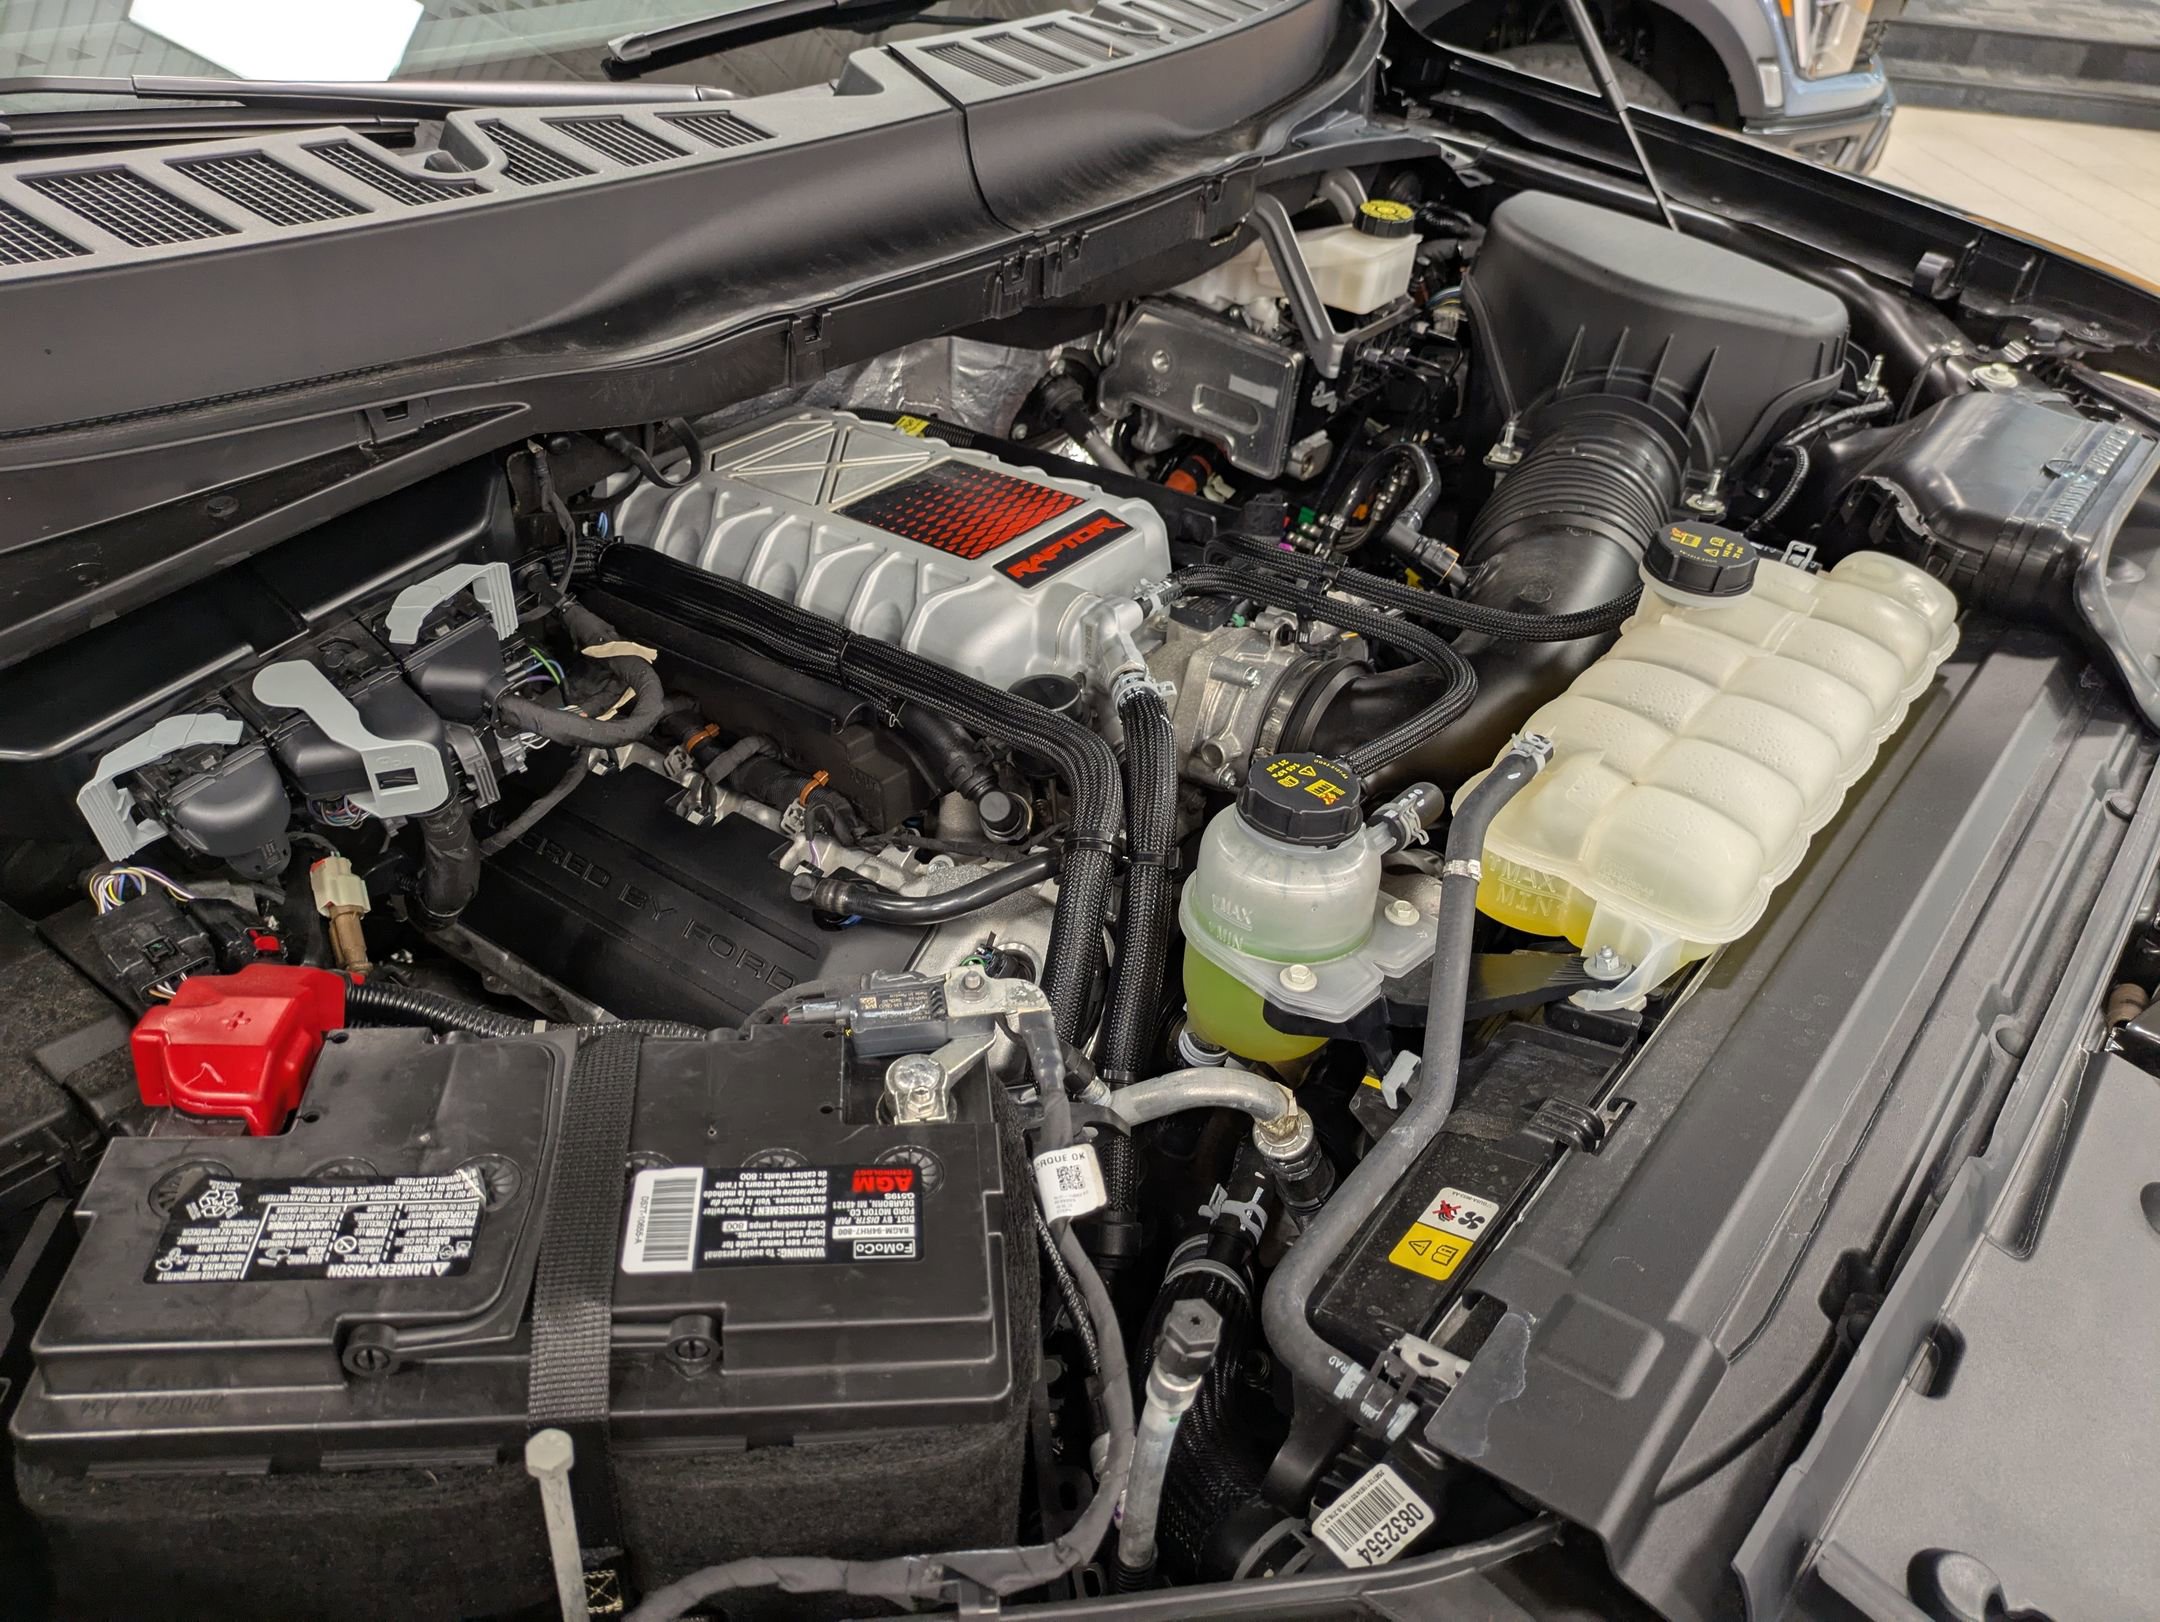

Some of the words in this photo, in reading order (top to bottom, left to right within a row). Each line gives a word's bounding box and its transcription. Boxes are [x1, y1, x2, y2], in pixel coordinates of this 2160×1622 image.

[1007, 516, 1127, 579] RAPTOR
[1500, 860, 1557, 893] MAX
[1495, 883, 1555, 917] MIN
[518, 832, 612, 889] ERED
[619, 883, 677, 921] BY
[682, 918, 797, 992] FORD
[1219, 896, 1253, 925] MAX
[1217, 925, 1244, 951] MIN
[1036, 1153, 1069, 1168] RQUE
[1071, 1152, 1087, 1162] OK
[764, 1172, 791, 1180] volants
[851, 1176, 913, 1192] AGM
[722, 1198, 744, 1207] guide
[754, 1198, 771, 1206] Voir
[813, 1196, 827, 1205] des
[869, 1199, 915, 1208] DEARBORN,
[727, 1207, 746, 1215] Pour
[752, 1205, 827, 1216] AVERTISSEMENT
[847, 1208, 861, 1217] CO.
[862, 1208, 891, 1217] MOTOR
[893, 1207, 915, 1216] FORD
[772, 1219, 806, 1230] cranking
[834, 1216, 852, 1225] PAR
[894, 1215, 915, 1224] DIST.
[749, 1220, 771, 1230] amps
[808, 1220, 826, 1230] Cold
[785, 1230, 804, 1238] start
[805, 1229, 826, 1238] jump
[721, 1241, 734, 1249] for
[735, 1238, 758, 1249] guide
[802, 1237, 826, 1247] injury
[776, 1248, 826, 1258] WARNING:
[855, 1242, 913, 1255] FoMoCo
[704, 1249, 740, 1260] personal
[741, 1249, 764, 1259] avoid
[327, 1262, 432, 1278] DANGER/POISON
[1328, 1354, 1350, 1374] RAD
[1355, 1501, 1425, 1566] 0832554
